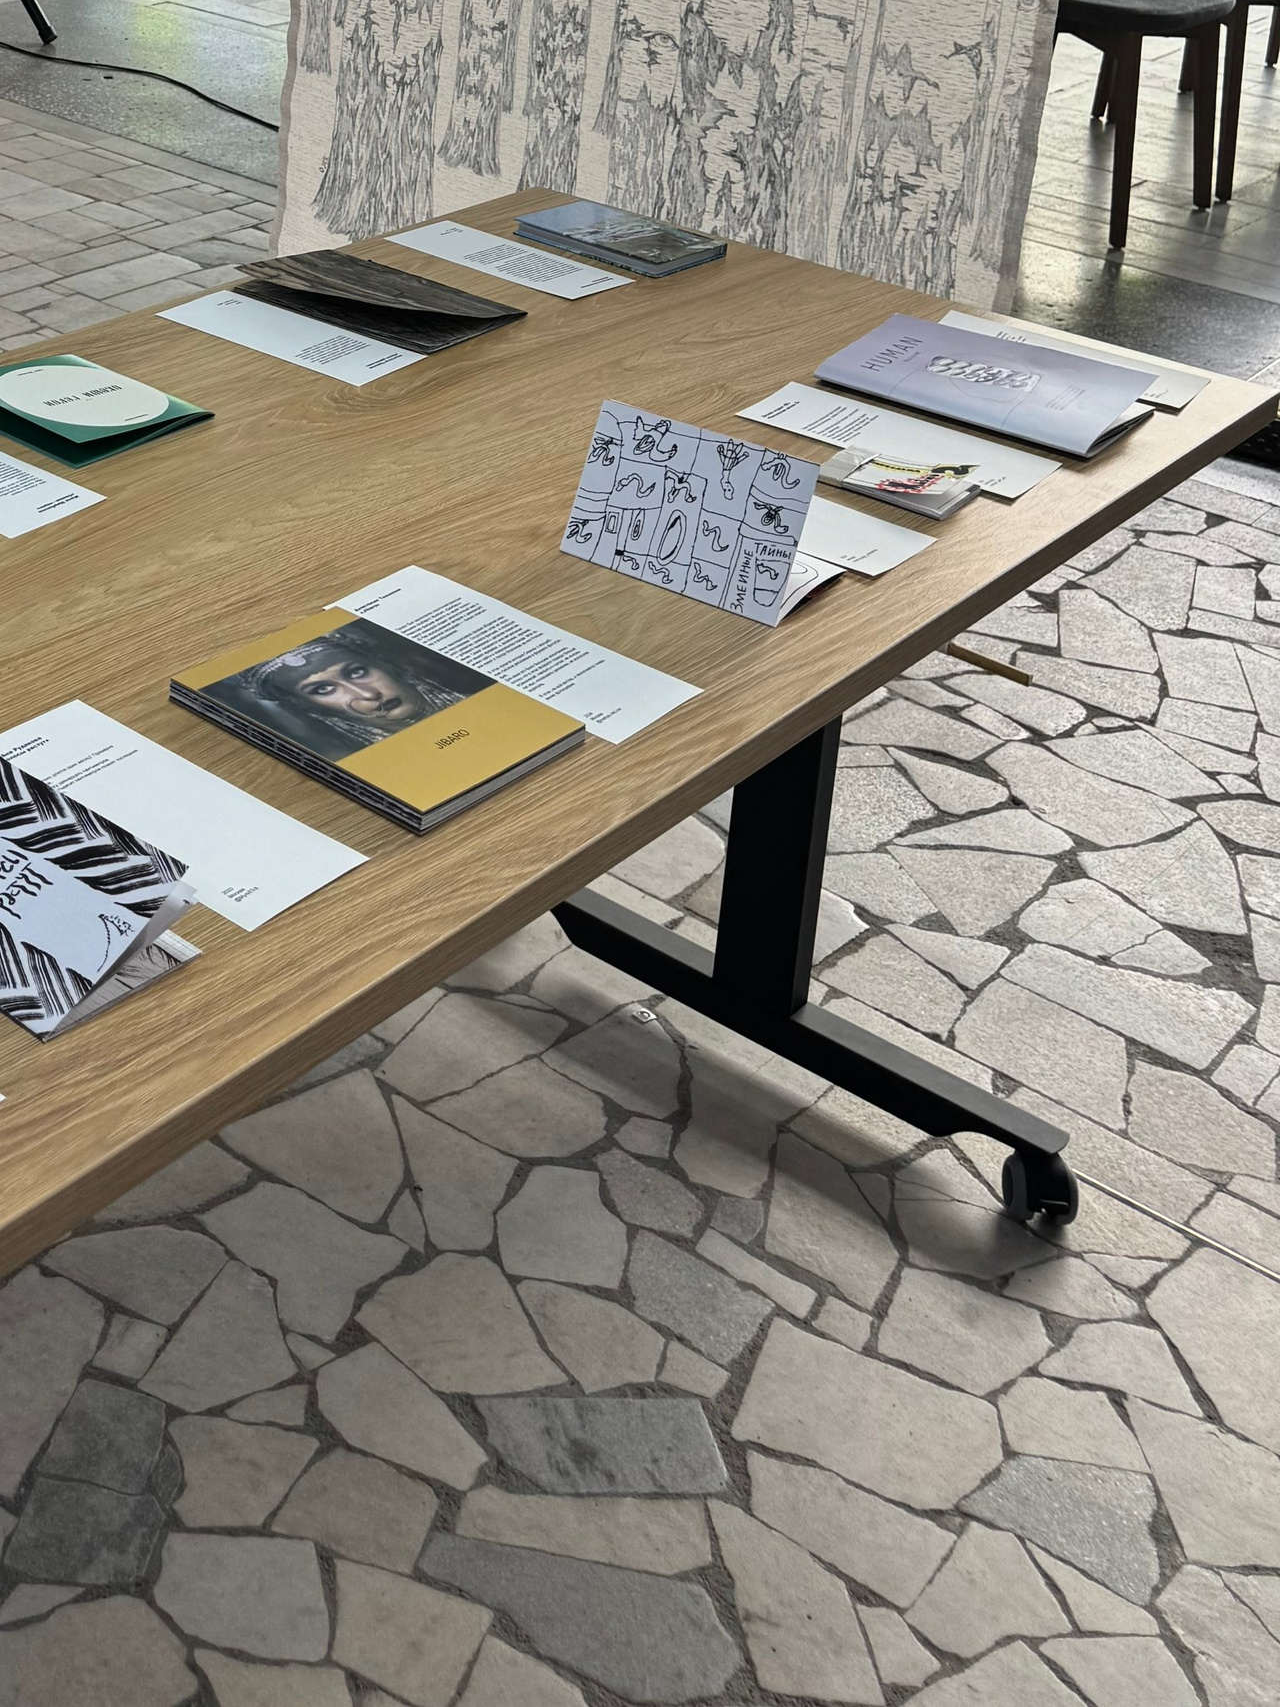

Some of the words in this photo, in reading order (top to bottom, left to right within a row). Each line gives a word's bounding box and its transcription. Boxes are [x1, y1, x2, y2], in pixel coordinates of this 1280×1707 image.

[860, 336, 924, 373] HUMAN
[754, 542, 792, 560] ТАЙНЫ
[730, 549, 754, 613] ЗМЕИНЫЕ
[436, 728, 471, 751] JIBARO
